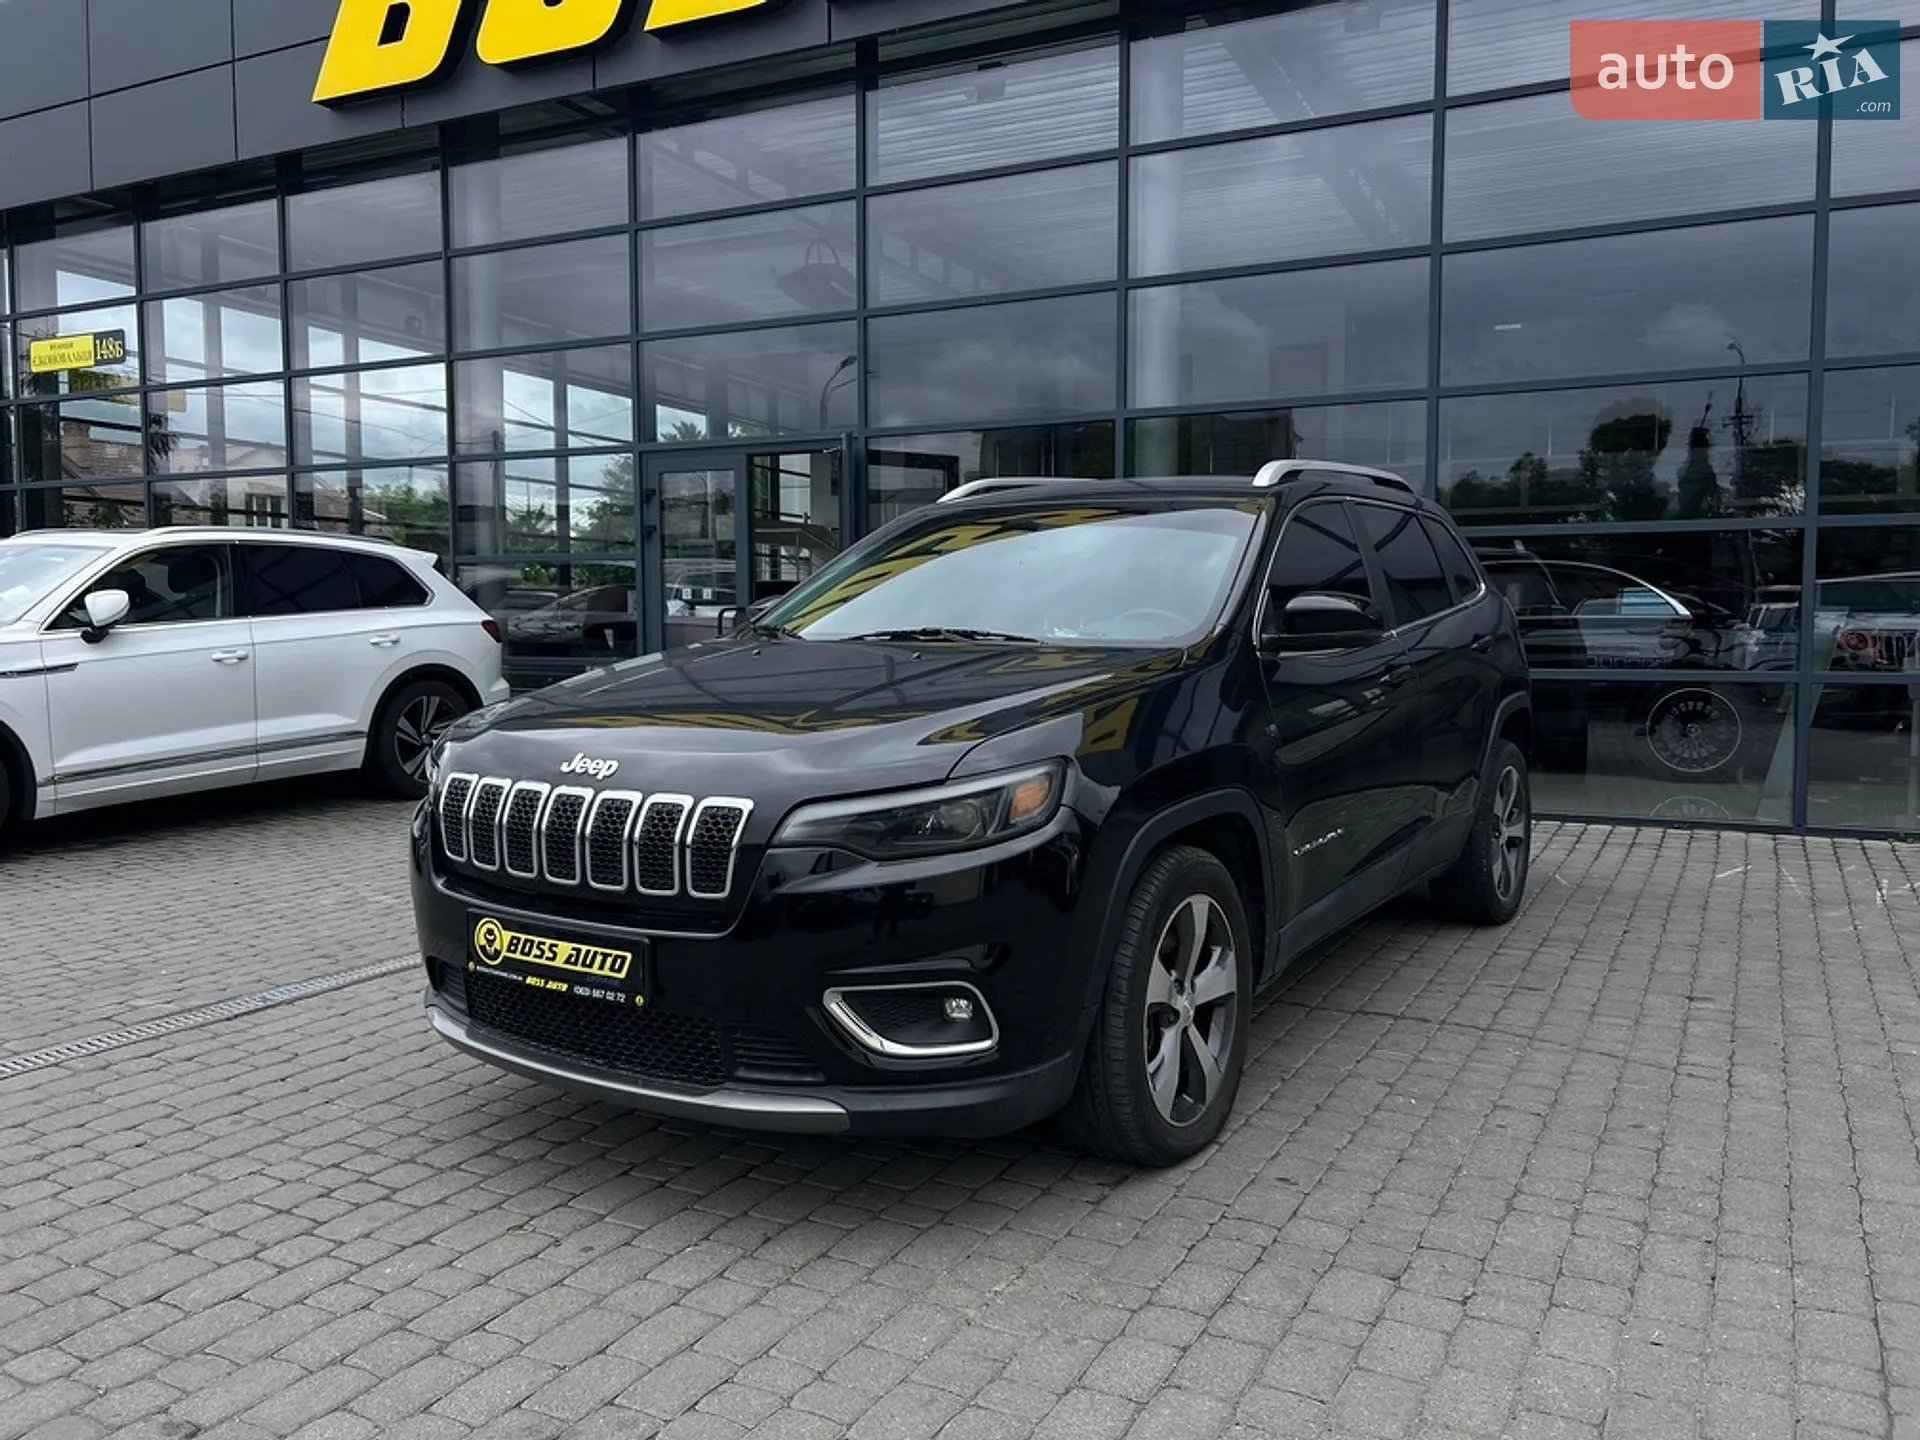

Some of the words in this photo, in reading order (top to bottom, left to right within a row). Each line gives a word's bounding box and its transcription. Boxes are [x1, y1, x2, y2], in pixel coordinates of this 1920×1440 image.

[560, 752, 619, 779] Jeep
[505, 935, 559, 962] BOSS
[562, 946, 628, 974] AUTO
